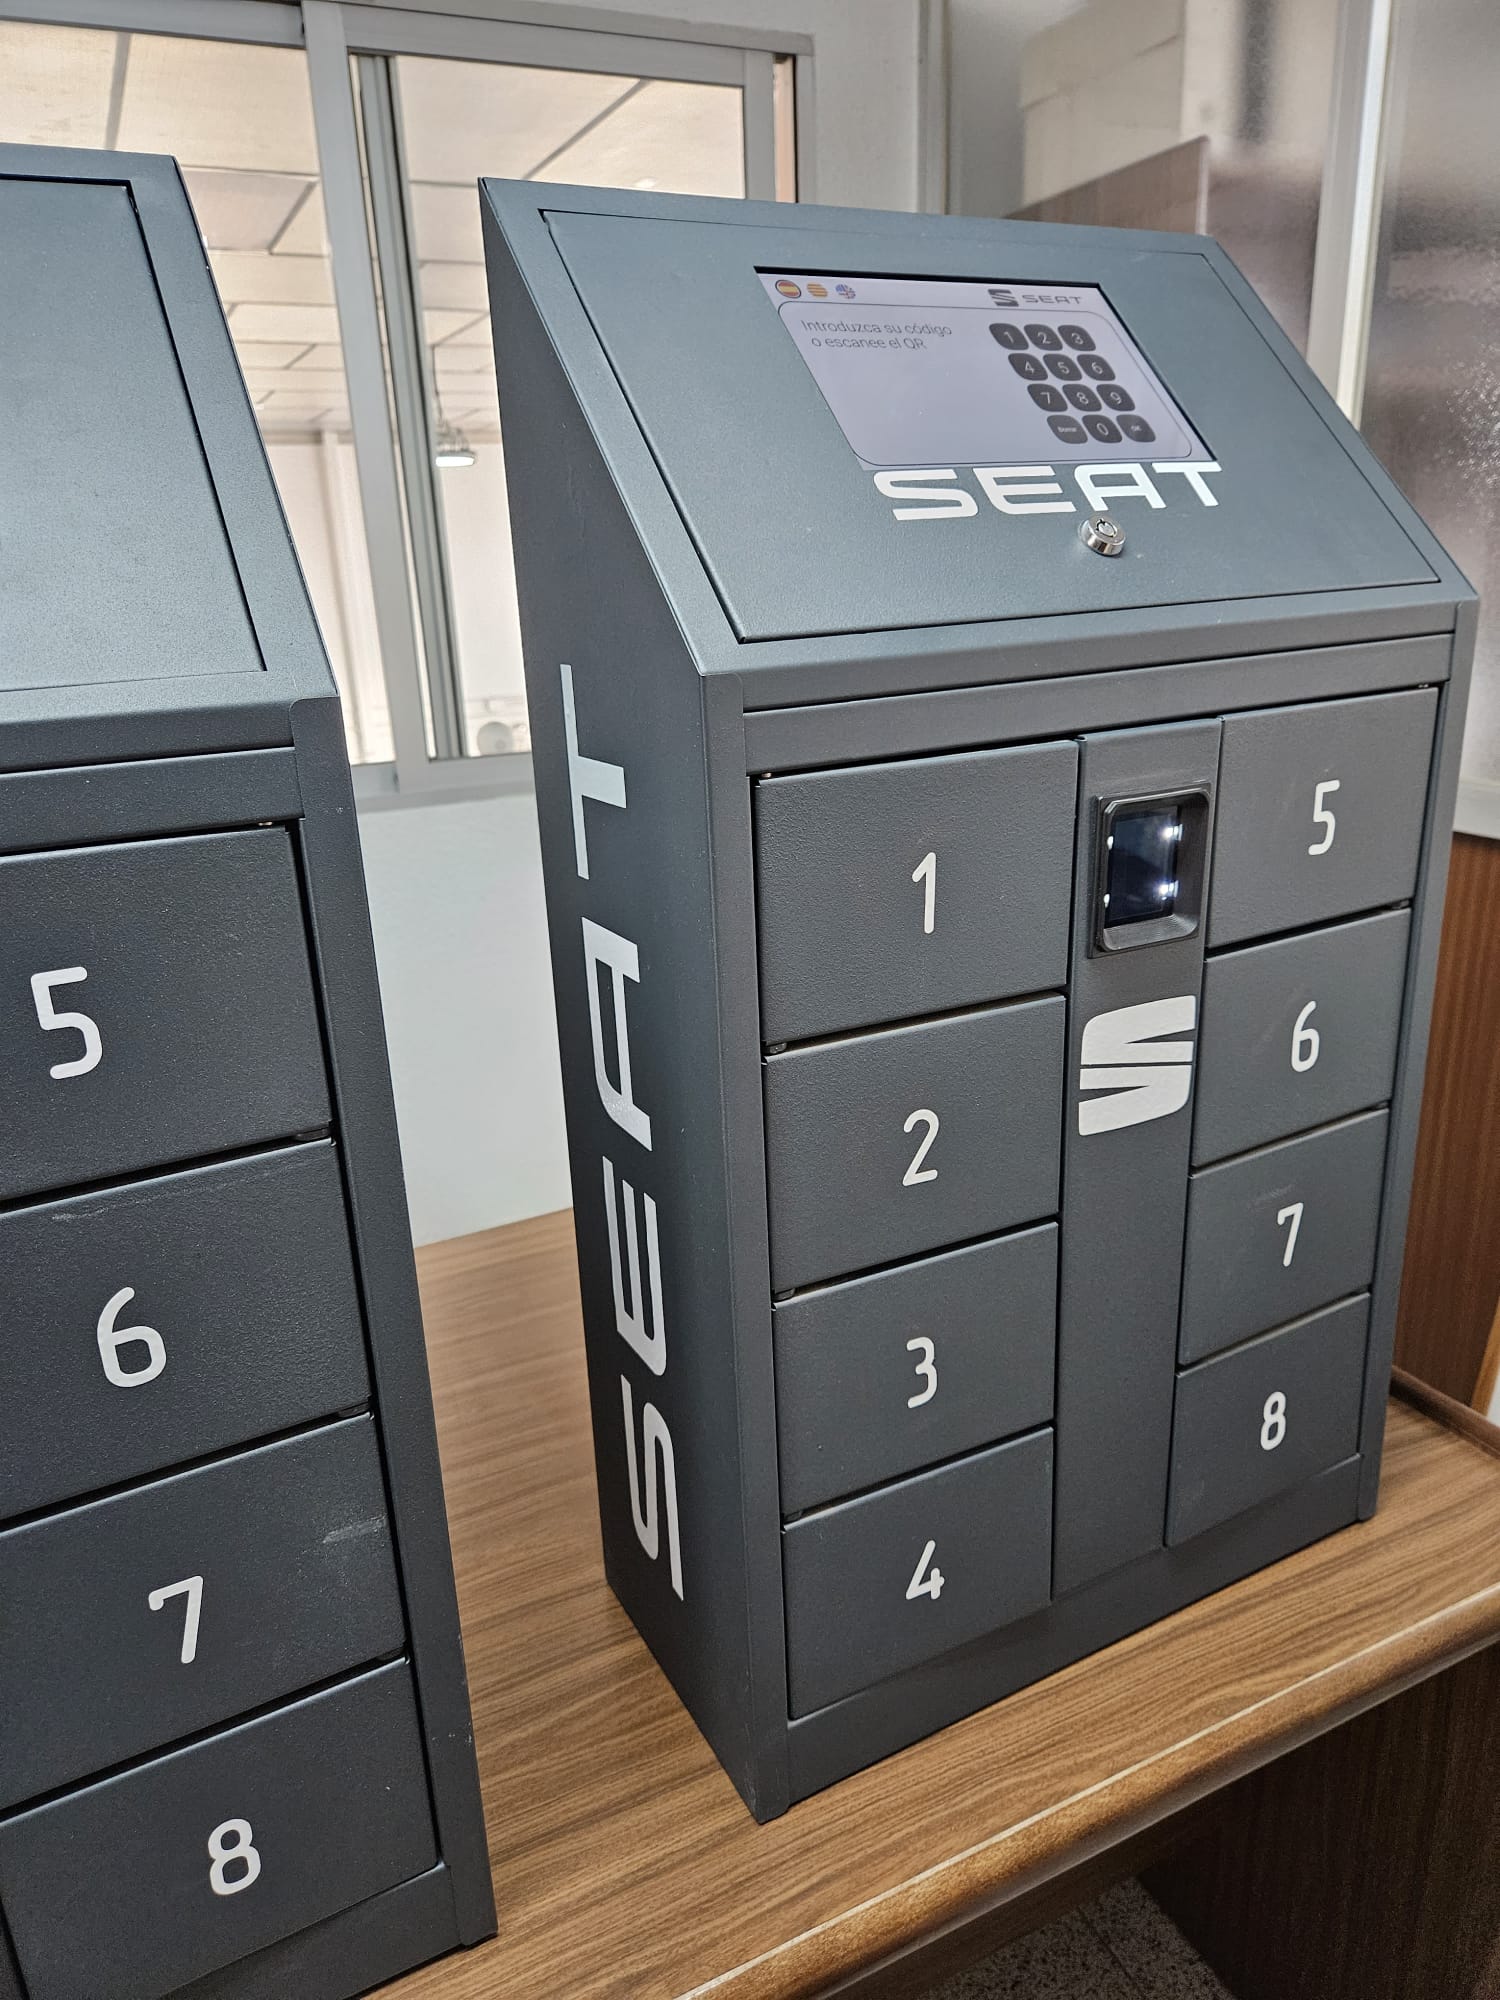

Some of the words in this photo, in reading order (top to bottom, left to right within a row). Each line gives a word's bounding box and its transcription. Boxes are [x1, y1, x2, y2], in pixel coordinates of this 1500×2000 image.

[801, 320, 882, 334] Introduzca
[884, 324, 902, 334] su
[904, 323, 953, 337] código
[1021, 294, 1084, 305] SEAT
[812, 338, 821, 348] o
[824, 339, 886, 349] escanee
[889, 338, 901, 349] el
[903, 338, 927, 350] QR
[1003, 331, 1015, 344] 1
[1037, 332, 1051, 344] 2
[1071, 332, 1084, 345] 3
[1024, 361, 1035, 374] 4
[1057, 362, 1070, 374] 5
[1091, 362, 1103, 375] 6
[1040, 392, 1051, 405] 7
[1076, 392, 1089, 405] 8
[1110, 392, 1122, 405] 9
[1096, 423, 1108, 436] 0
[874, 462, 1221, 520] SEAT
[1309, 780, 1340, 856] 5
[911, 852, 937, 934] 1
[31, 967, 102, 1080] 5
[1291, 1001, 1320, 1072] 6
[559, 663, 685, 1602] SEAT
[902, 1109, 939, 1187] 2
[1278, 1203, 1303, 1267] 7
[97, 1287, 167, 1388] 6
[906, 1336, 938, 1409] 3
[1260, 1391, 1286, 1451] 8
[905, 1541, 944, 1600] 4
[149, 1576, 203, 1664] 7
[207, 1818, 262, 1896] 8
